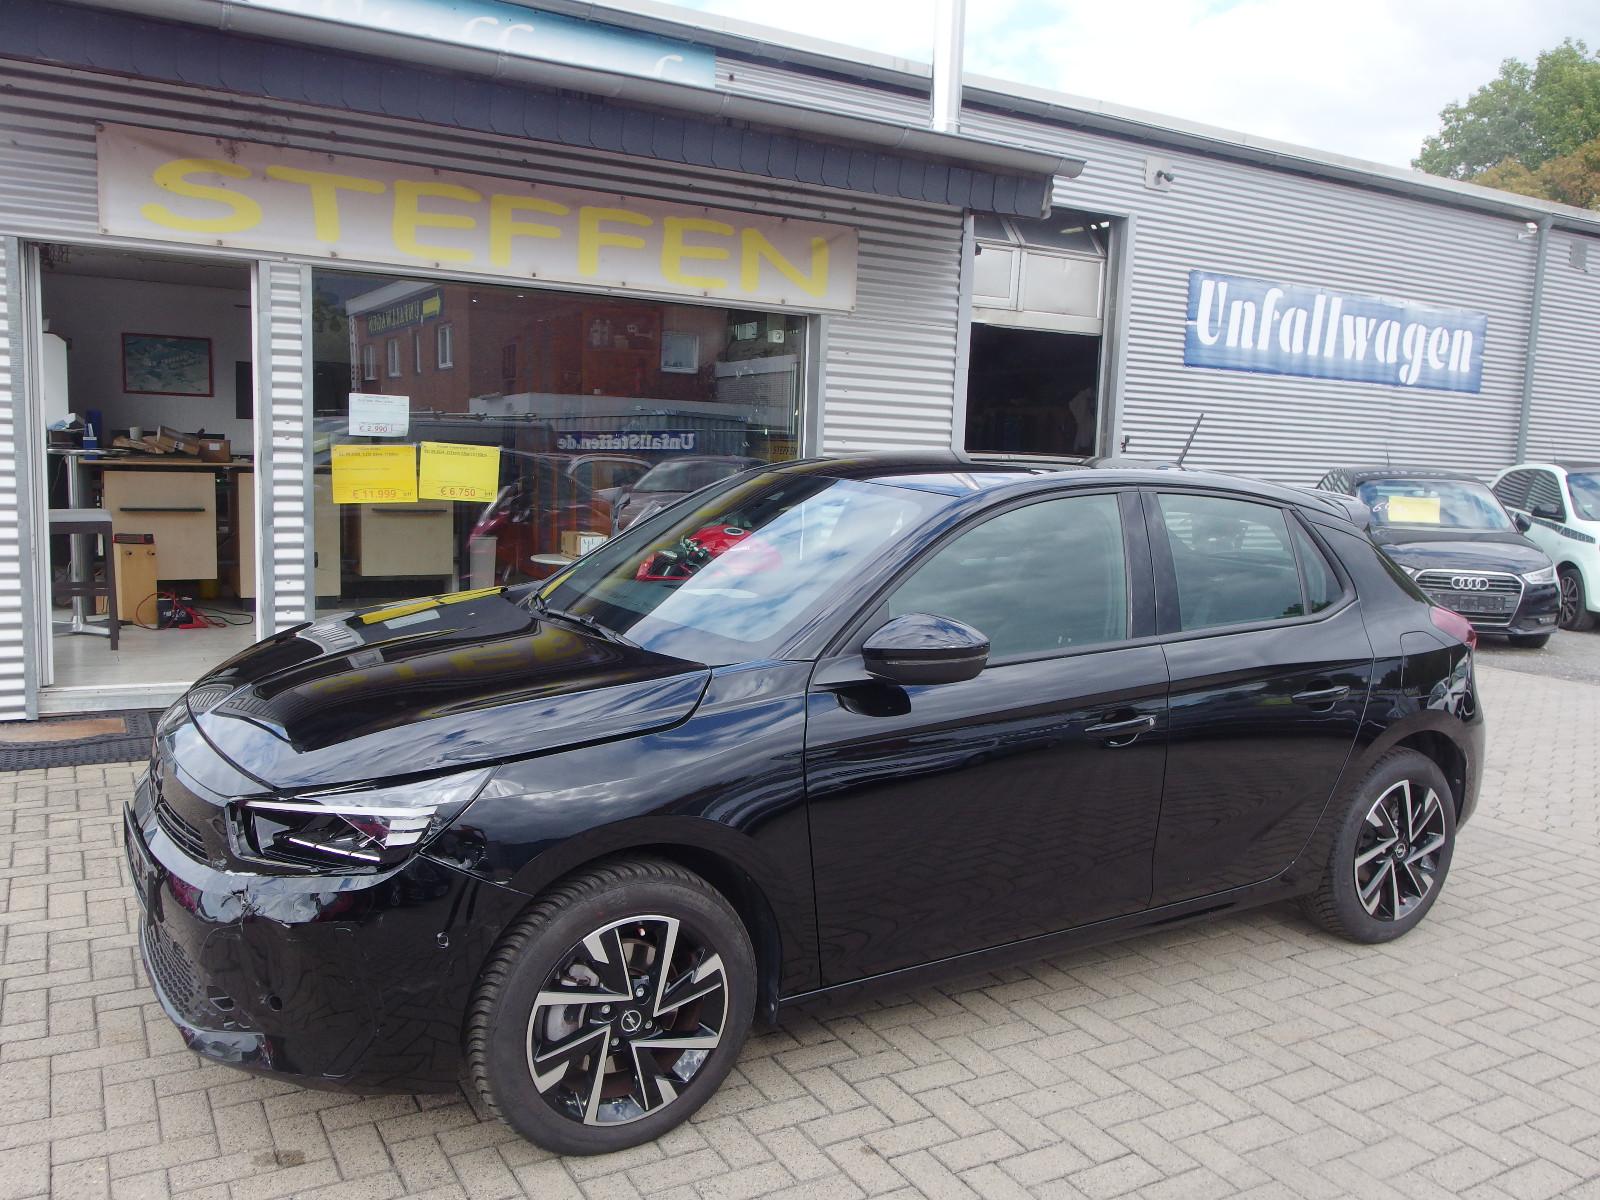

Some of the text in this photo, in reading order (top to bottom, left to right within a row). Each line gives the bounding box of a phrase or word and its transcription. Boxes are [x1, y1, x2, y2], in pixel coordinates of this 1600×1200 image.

[141, 158, 828, 297] STEFFEN
[1196, 279, 1473, 385] Unfallwagen
[449, 487, 476, 497] 6.750
